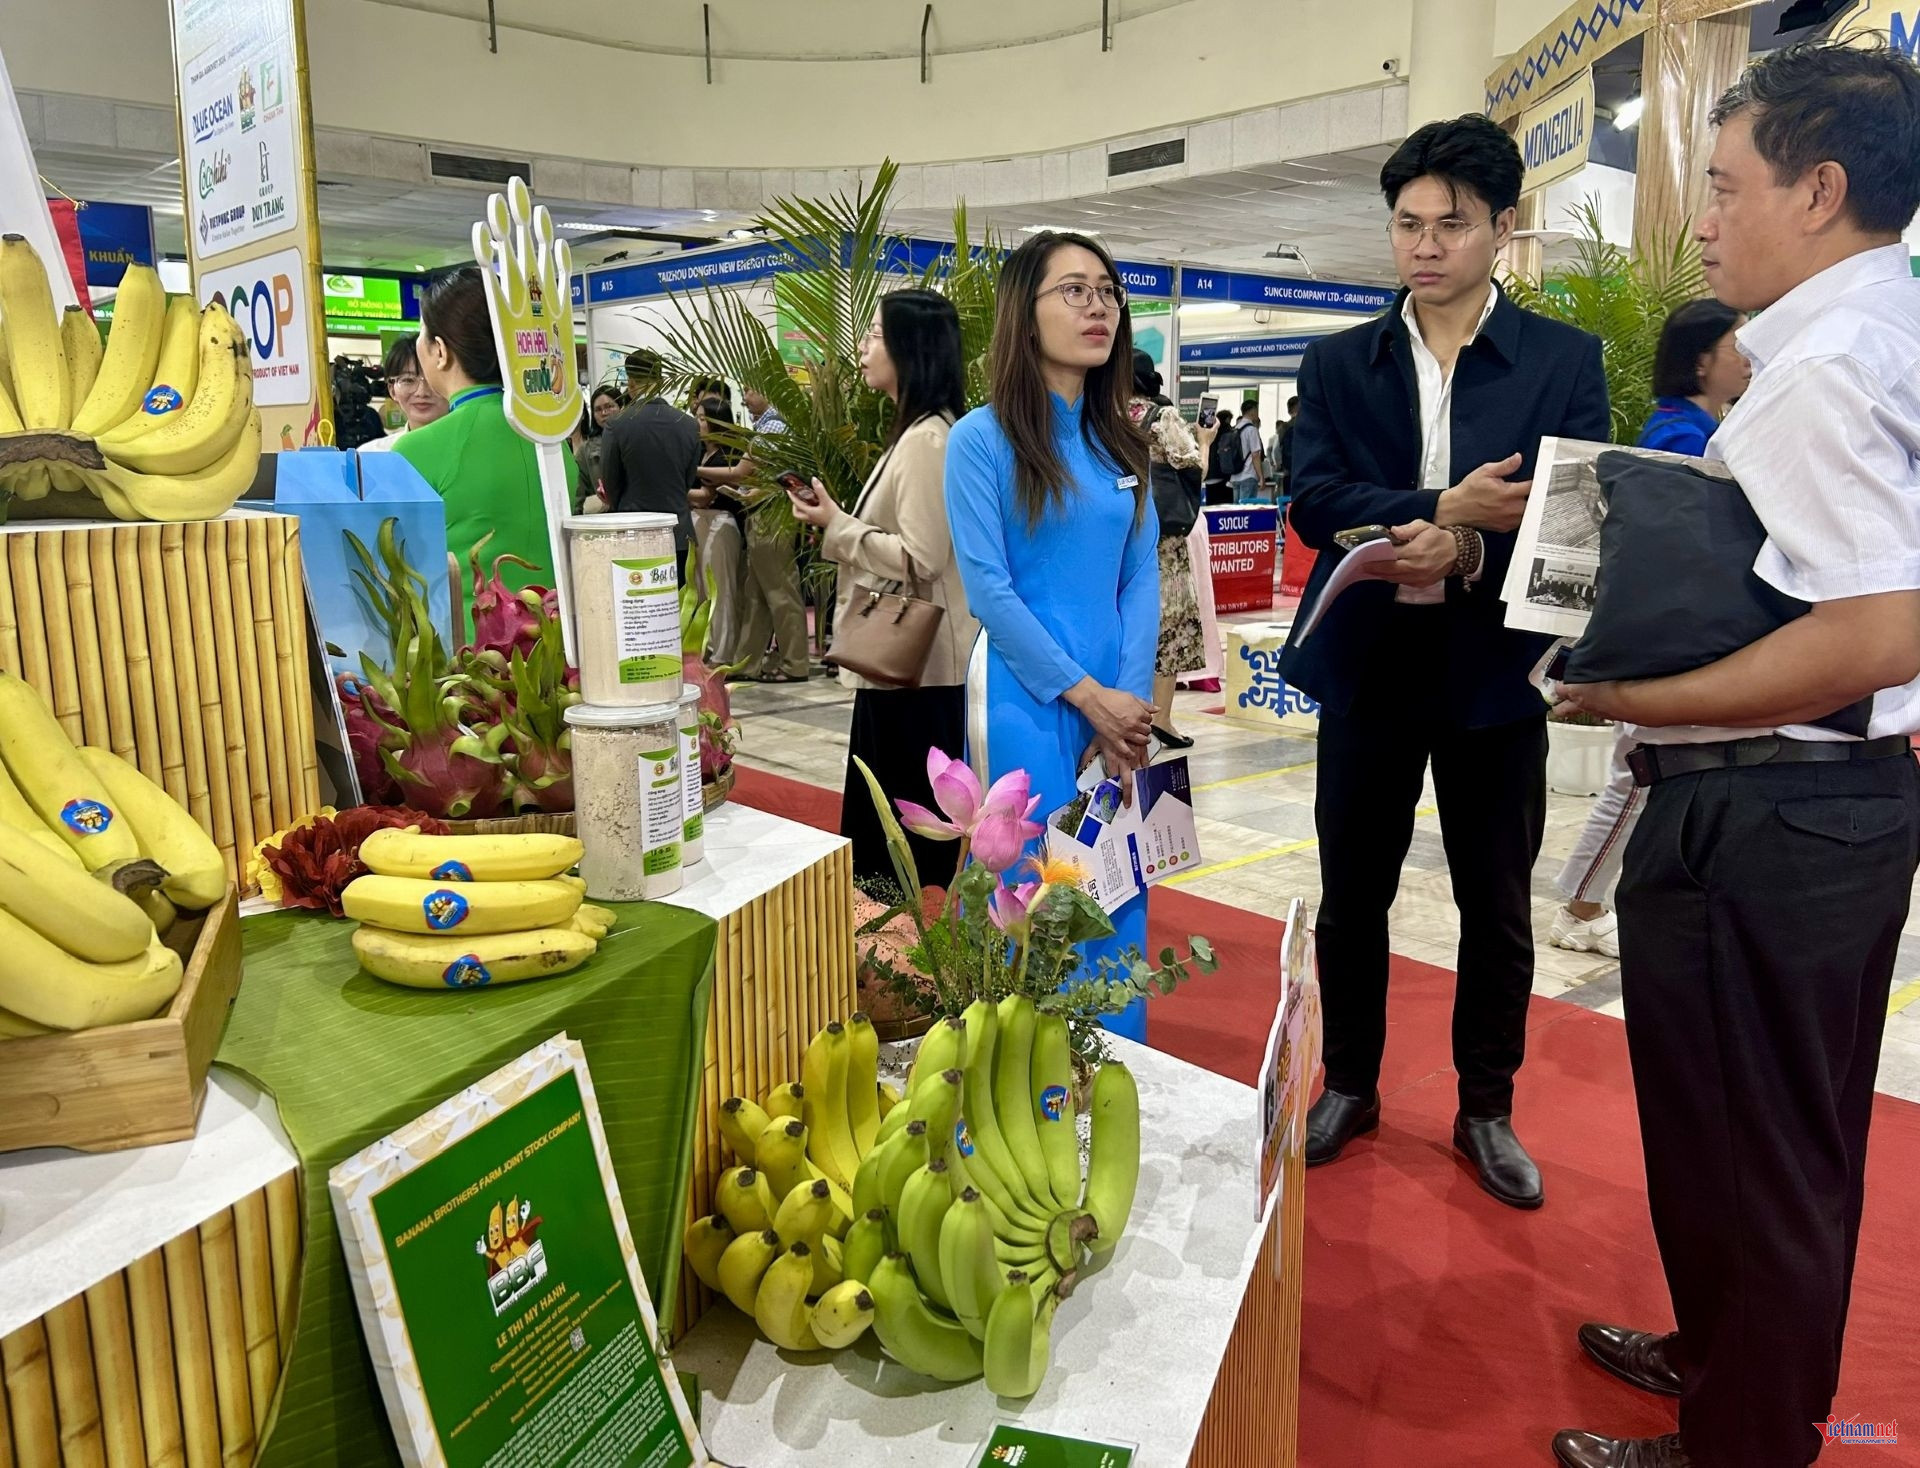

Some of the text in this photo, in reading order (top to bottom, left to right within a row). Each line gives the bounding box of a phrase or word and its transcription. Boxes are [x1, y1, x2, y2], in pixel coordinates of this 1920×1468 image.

[208, 94, 234, 126] OCEAN
[1524, 96, 1584, 170] MONGOLIA
[230, 205, 245, 222] GROUP
[252, 204, 263, 222] DUY
[264, 196, 284, 219] TRANG
[88, 248, 135, 264] KHUẨN
[657, 267, 687, 284] TAIZHOU
[688, 266, 718, 278] DONGFU
[718, 263, 736, 275] NEW
[736, 256, 766, 272] ENERGY
[601, 280, 614, 292] A15
[1198, 278, 1212, 290] A14
[1264, 286, 1292, 299] SUNCUE
[1293, 289, 1326, 302] COMPANY
[1344, 293, 1364, 304] GRAIN
[1364, 295, 1385, 306] DRYER
[516, 331, 533, 354] HOA
[1240, 345, 1262, 353] SCIENCE
[1262, 344, 1276, 352] AND
[271, 366, 278, 377] OF
[278, 365, 289, 376] VIET
[290, 364, 300, 376] NAM
[1211, 558, 1254, 574] WANTED
[396, 1110, 582, 1248] BANANA BROTHERS FARM JOINT STOCK COMPANY
[488, 1239, 547, 1308] BBF
[496, 1332, 508, 1349] LE
[508, 1317, 524, 1338] THI
[524, 1304, 538, 1324] MY
[539, 1282, 567, 1310] HANH
[534, 1316, 552, 1334] Board
